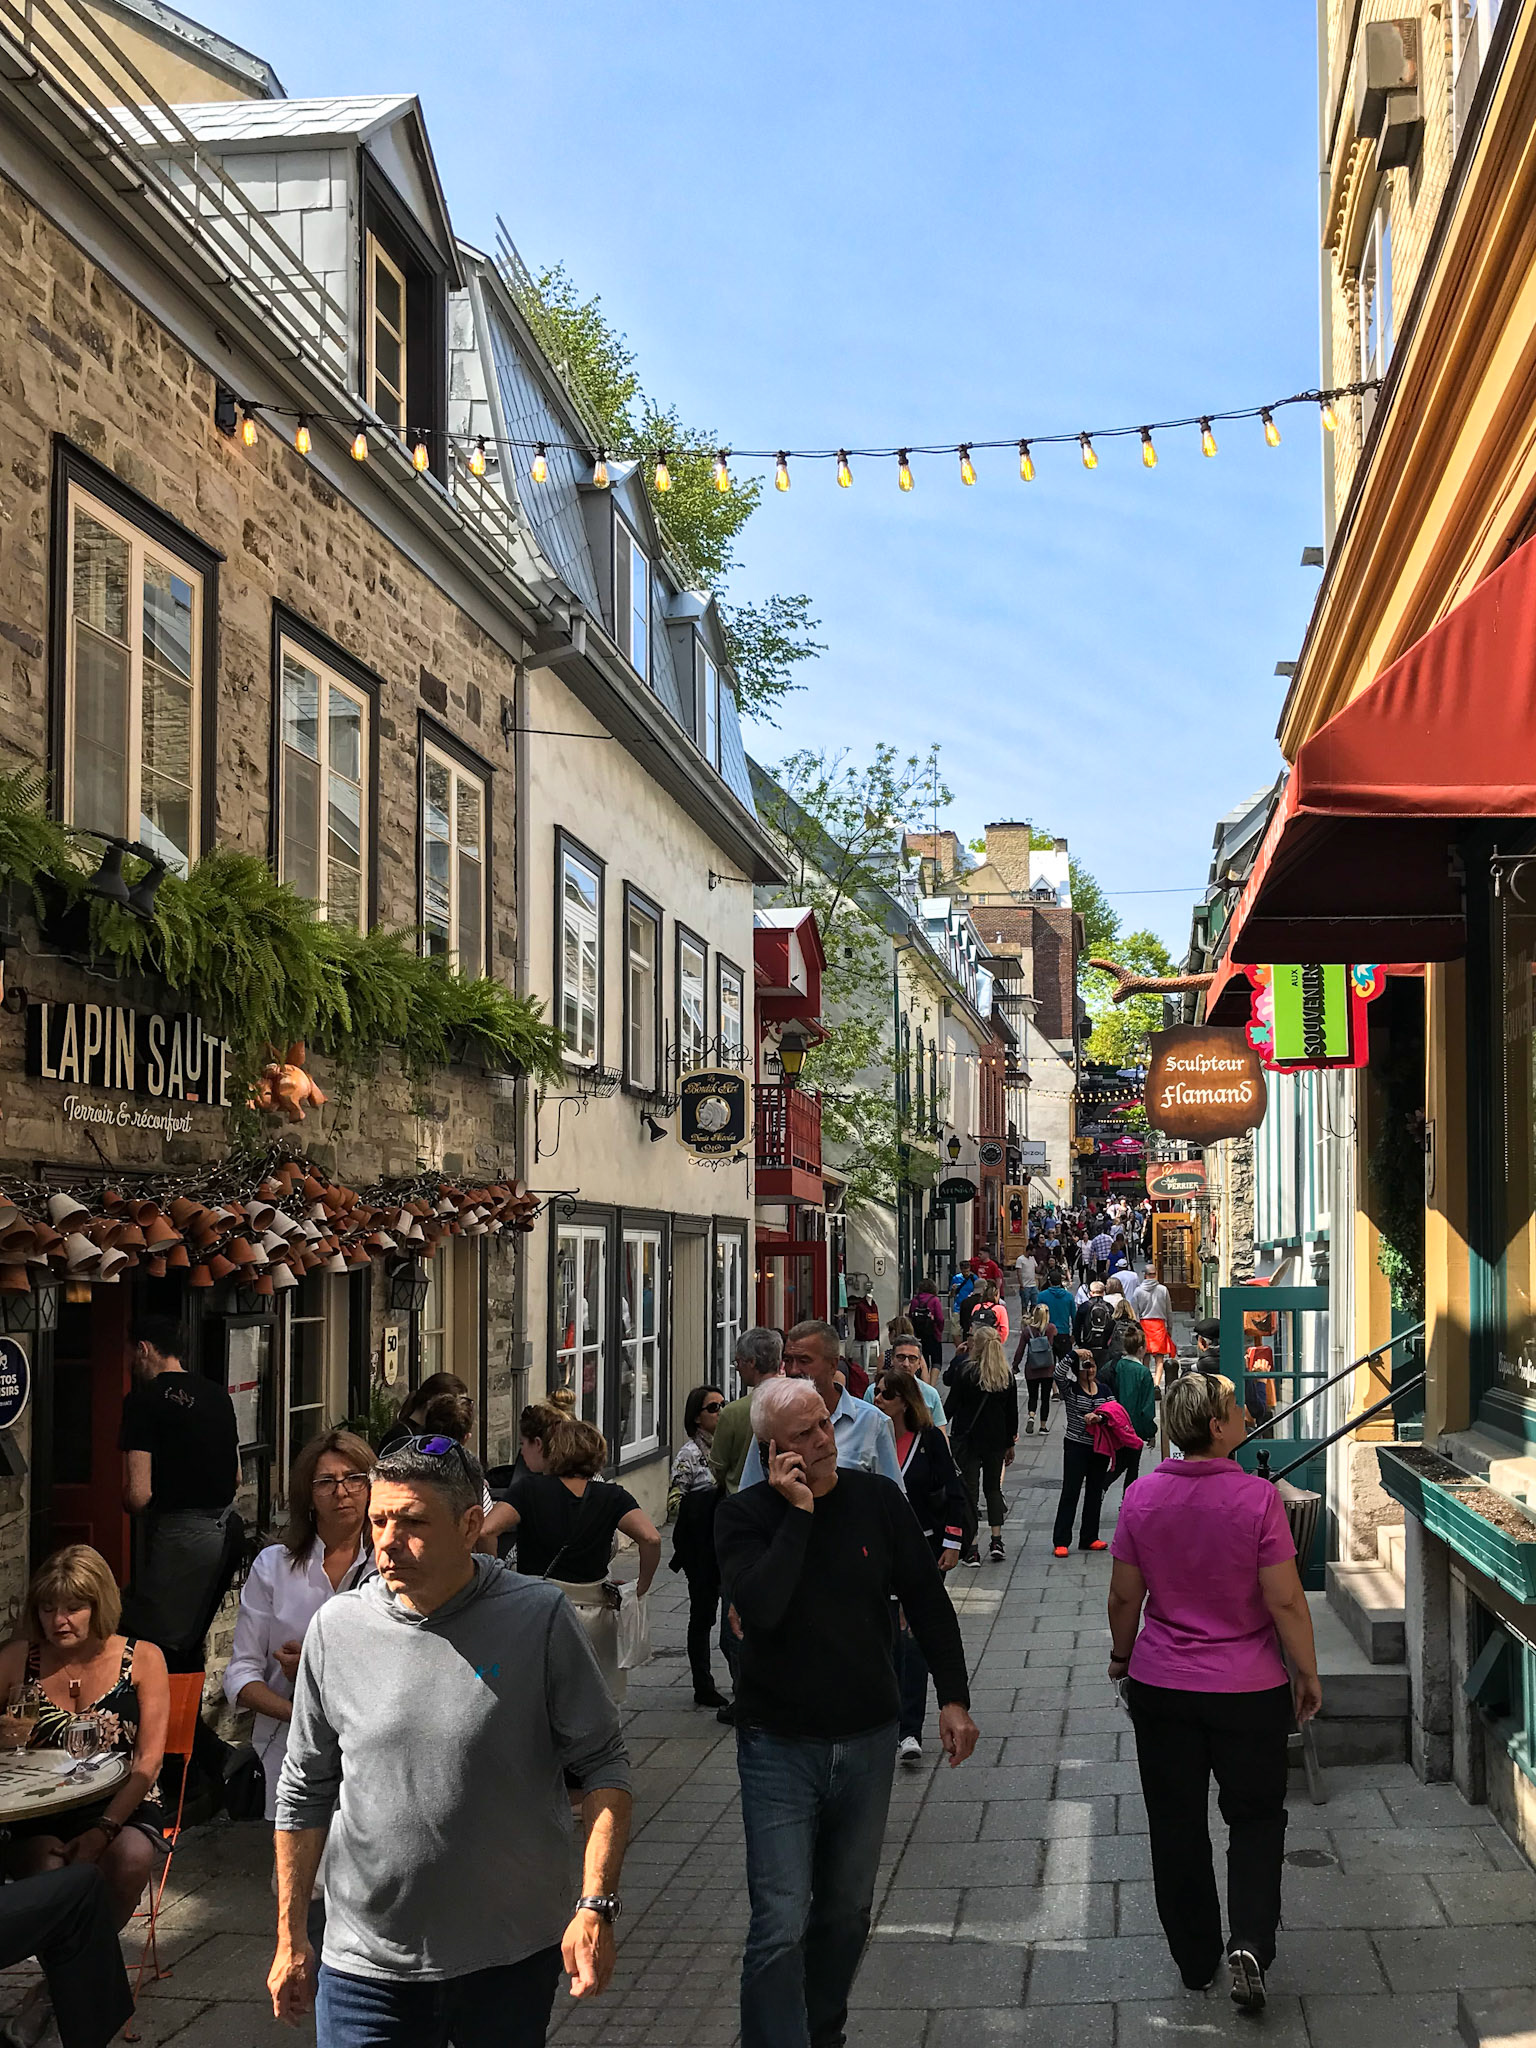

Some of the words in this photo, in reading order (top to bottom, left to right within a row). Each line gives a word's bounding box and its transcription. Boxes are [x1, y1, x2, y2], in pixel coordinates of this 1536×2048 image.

[1291, 969, 1299, 987] AUX
[41, 1003, 135, 1091] LAPIN
[148, 1012, 233, 1108] SAUTÉ
[1165, 1054, 1245, 1075] Sculpteur
[1160, 1081, 1252, 1108] Flamand
[64, 1095, 115, 1126] Terroir
[116, 1101, 130, 1127] &
[131, 1108, 193, 1142] réconfort
[1023, 1147, 1045, 1156] bizou
[387, 1335, 397, 1352] 50
[0, 1374, 17, 1386] TOS
[0, 1385, 19, 1397] SIRS
